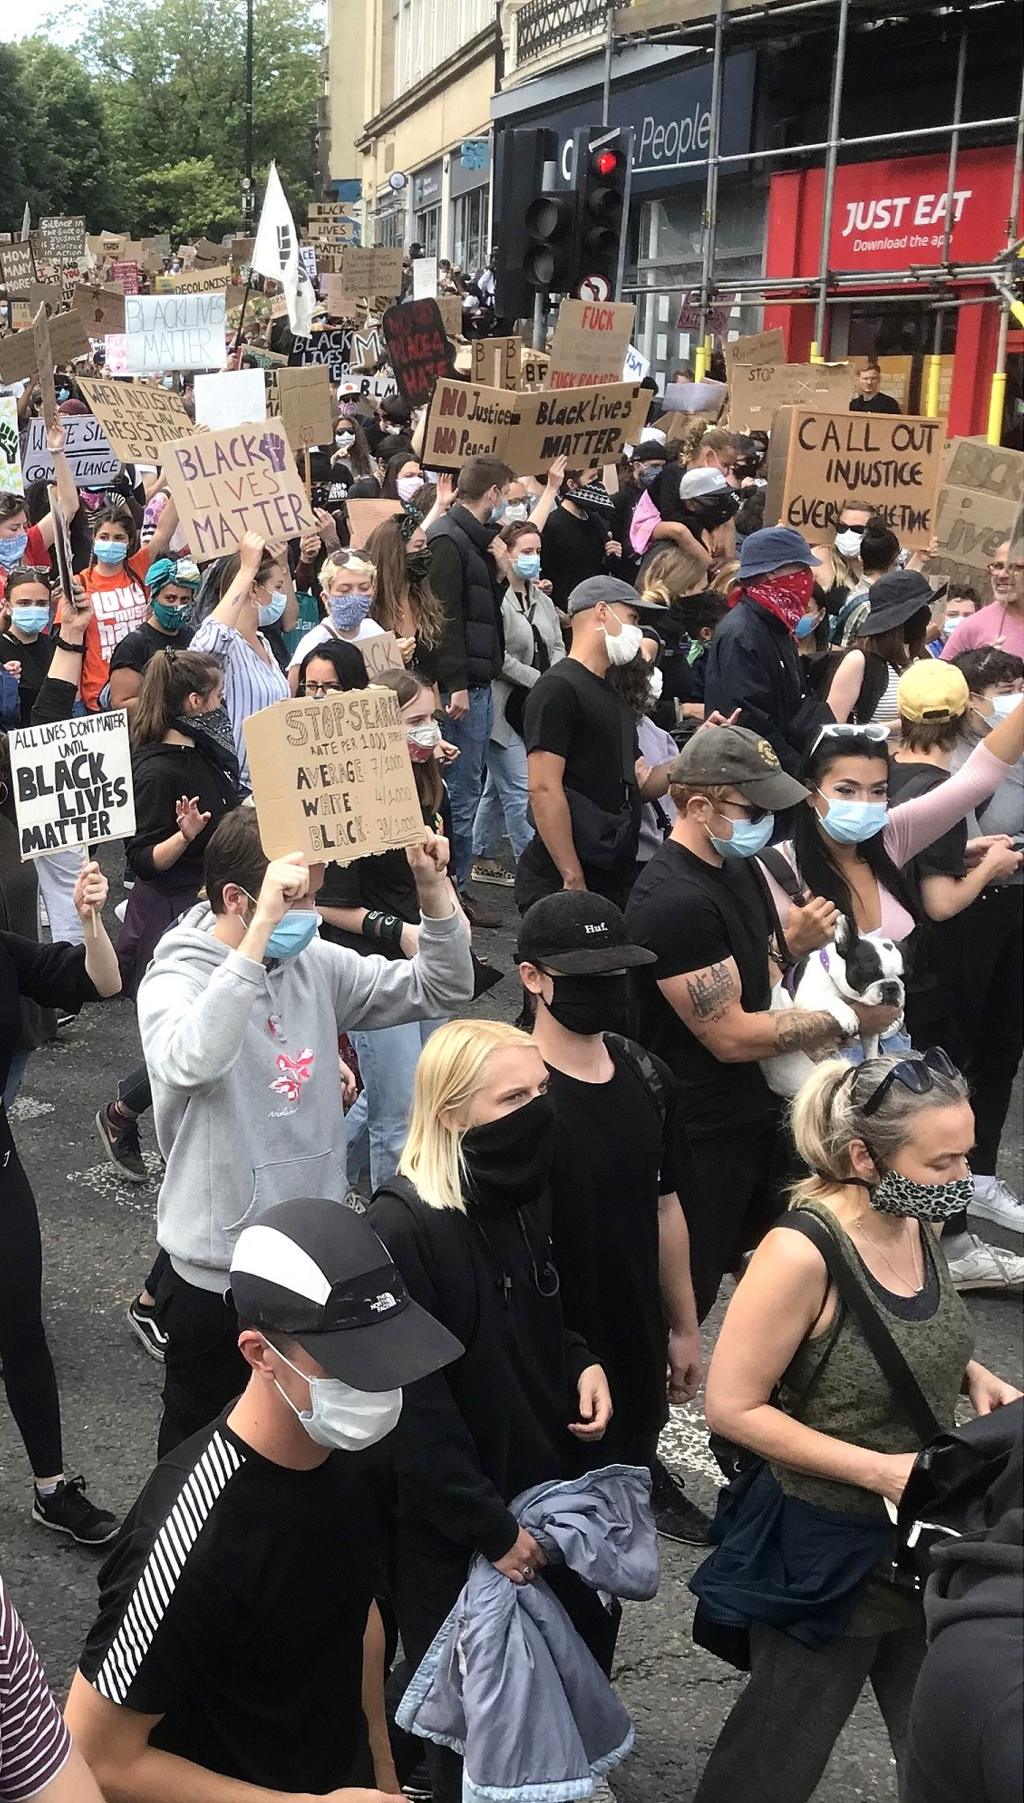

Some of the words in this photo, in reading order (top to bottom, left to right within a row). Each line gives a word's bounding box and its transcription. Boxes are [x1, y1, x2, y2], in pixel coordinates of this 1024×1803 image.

[639, 102, 712, 164] People
[317, 203, 345, 215] BLACK
[842, 197, 911, 237] JUST
[914, 190, 973, 226] EAT
[318, 224, 346, 236] LIVES
[853, 236, 907, 251] Download
[910, 235, 929, 248] the
[2, 248, 31, 263] HOW
[53, 262, 78, 273] SAND
[3, 262, 34, 278] MANY
[6, 275, 36, 294] MORE?
[176, 277, 231, 295] DECOLONISE
[126, 299, 185, 335] BLACK
[185, 295, 225, 327] LIVES
[580, 306, 615, 331] FUCK
[143, 328, 213, 366] MATTER
[293, 330, 354, 354] BLACK
[302, 349, 343, 365] LIVES
[550, 370, 575, 389] FUCK
[748, 367, 775, 382] STOP
[88, 382, 126, 408] WHEN
[126, 389, 186, 415] INJUSTICE
[360, 378, 397, 398] BLM
[114, 408, 124, 419] IS
[125, 409, 150, 424] THE
[154, 411, 174, 425] LAW
[439, 387, 467, 416] NO
[468, 390, 512, 425] Justice
[536, 399, 590, 426] Black
[590, 393, 632, 422] lives
[33, 422, 77, 451] WTE
[433, 427, 457, 455] NO
[798, 417, 881, 453] CALL
[891, 423, 940, 455] OUT
[127, 443, 142, 458] IS
[175, 433, 266, 482] BLACK
[826, 458, 924, 491] INJUSTICE
[187, 468, 280, 511] LIVES
[192, 493, 311, 554] MATTER
[14, 728, 38, 750] ALL
[40, 723, 67, 745] LIVES
[69, 717, 95, 738] DONT
[96, 712, 126, 733] MATTER
[58, 740, 89, 759] UNTIL
[341, 738, 357, 753] PER
[16, 752, 108, 803] BLACK
[57, 776, 129, 819] LIVES
[22, 811, 111, 854] MATTER
